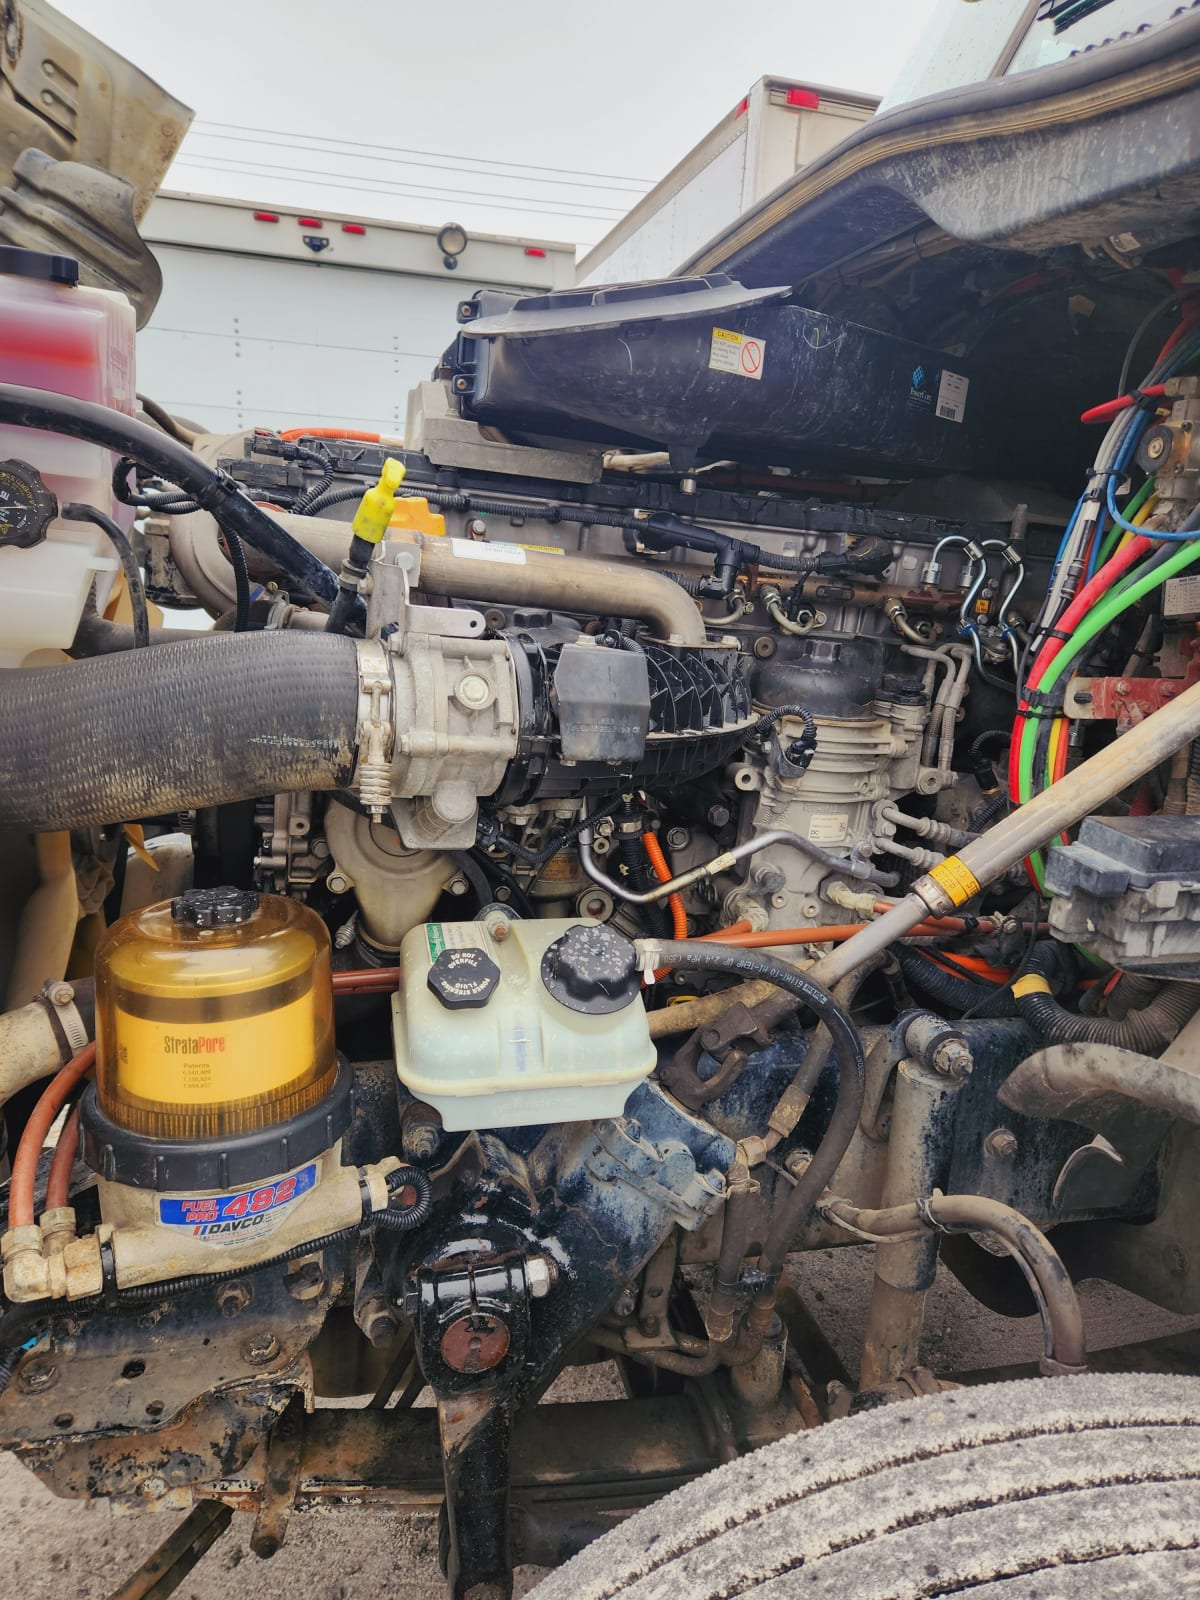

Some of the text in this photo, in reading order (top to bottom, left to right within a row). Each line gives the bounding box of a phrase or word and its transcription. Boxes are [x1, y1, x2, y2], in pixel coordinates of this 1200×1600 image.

[717, 331, 739, 341] CAUTION
[954, 864, 969, 879] NO
[462, 952, 476, 960] NOT
[447, 958, 478, 969] OVERFILL
[440, 977, 490, 996] POWER STEERING
[455, 981, 478, 989] FLUID
[163, 1035, 226, 1054] StrataPore
[181, 1199, 219, 1213] FUEL
[222, 1176, 298, 1218] 482
[185, 1210, 219, 1223] PRO
[208, 1213, 265, 1235] DAVCO
